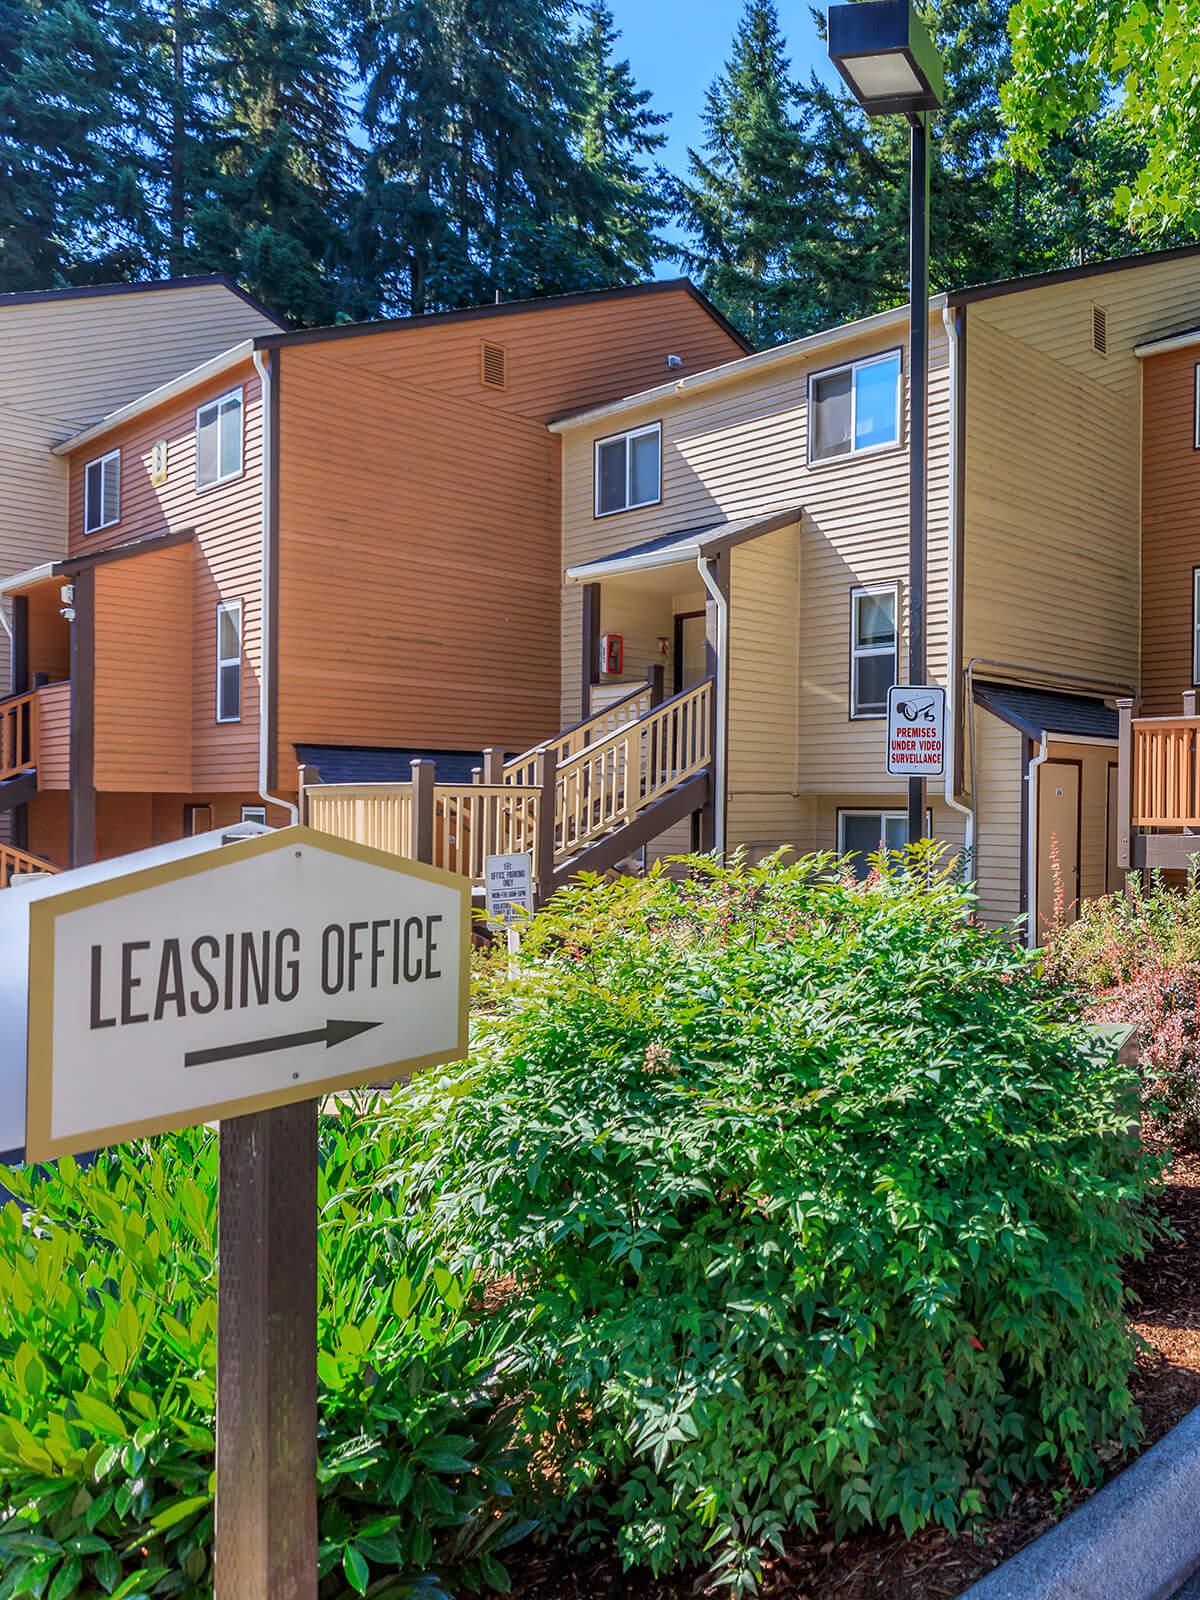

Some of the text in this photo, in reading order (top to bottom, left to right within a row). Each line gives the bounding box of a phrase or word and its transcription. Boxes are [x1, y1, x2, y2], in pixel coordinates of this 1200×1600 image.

[896, 728, 936, 738] PREMISES
[892, 740, 941, 750] UNDER VIDEO
[892, 754, 942, 764] SURVEILLANCE
[90, 914, 443, 1030] LEASING OFFICE
